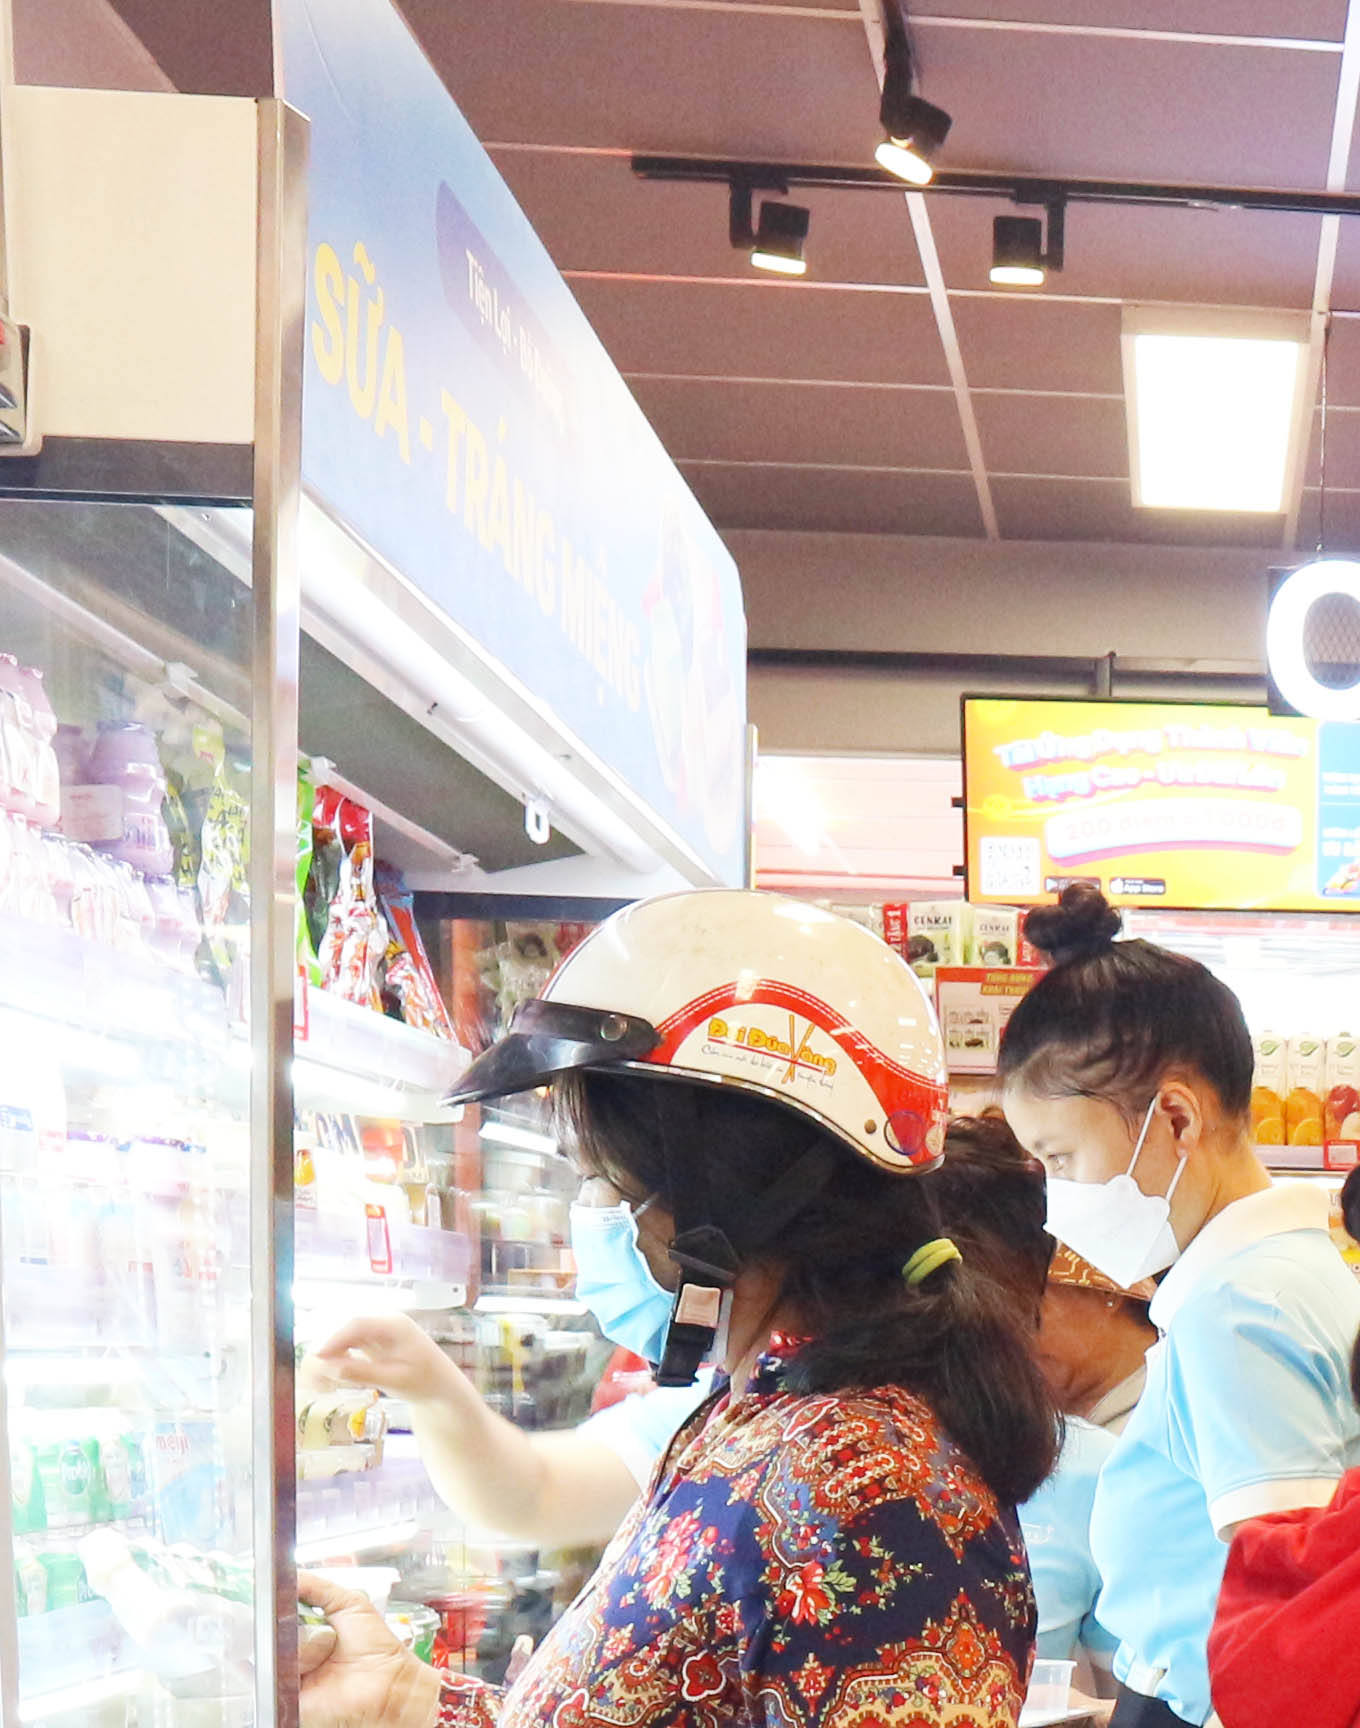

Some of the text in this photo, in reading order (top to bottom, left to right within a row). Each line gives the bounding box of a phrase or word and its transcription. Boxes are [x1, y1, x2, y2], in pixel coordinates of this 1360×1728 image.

[311, 242, 411, 465] SỮA
[440, 386, 557, 617] TRÁNG
[561, 543, 643, 713] MIỆNG
[154, 1434, 191, 1456] meiji
